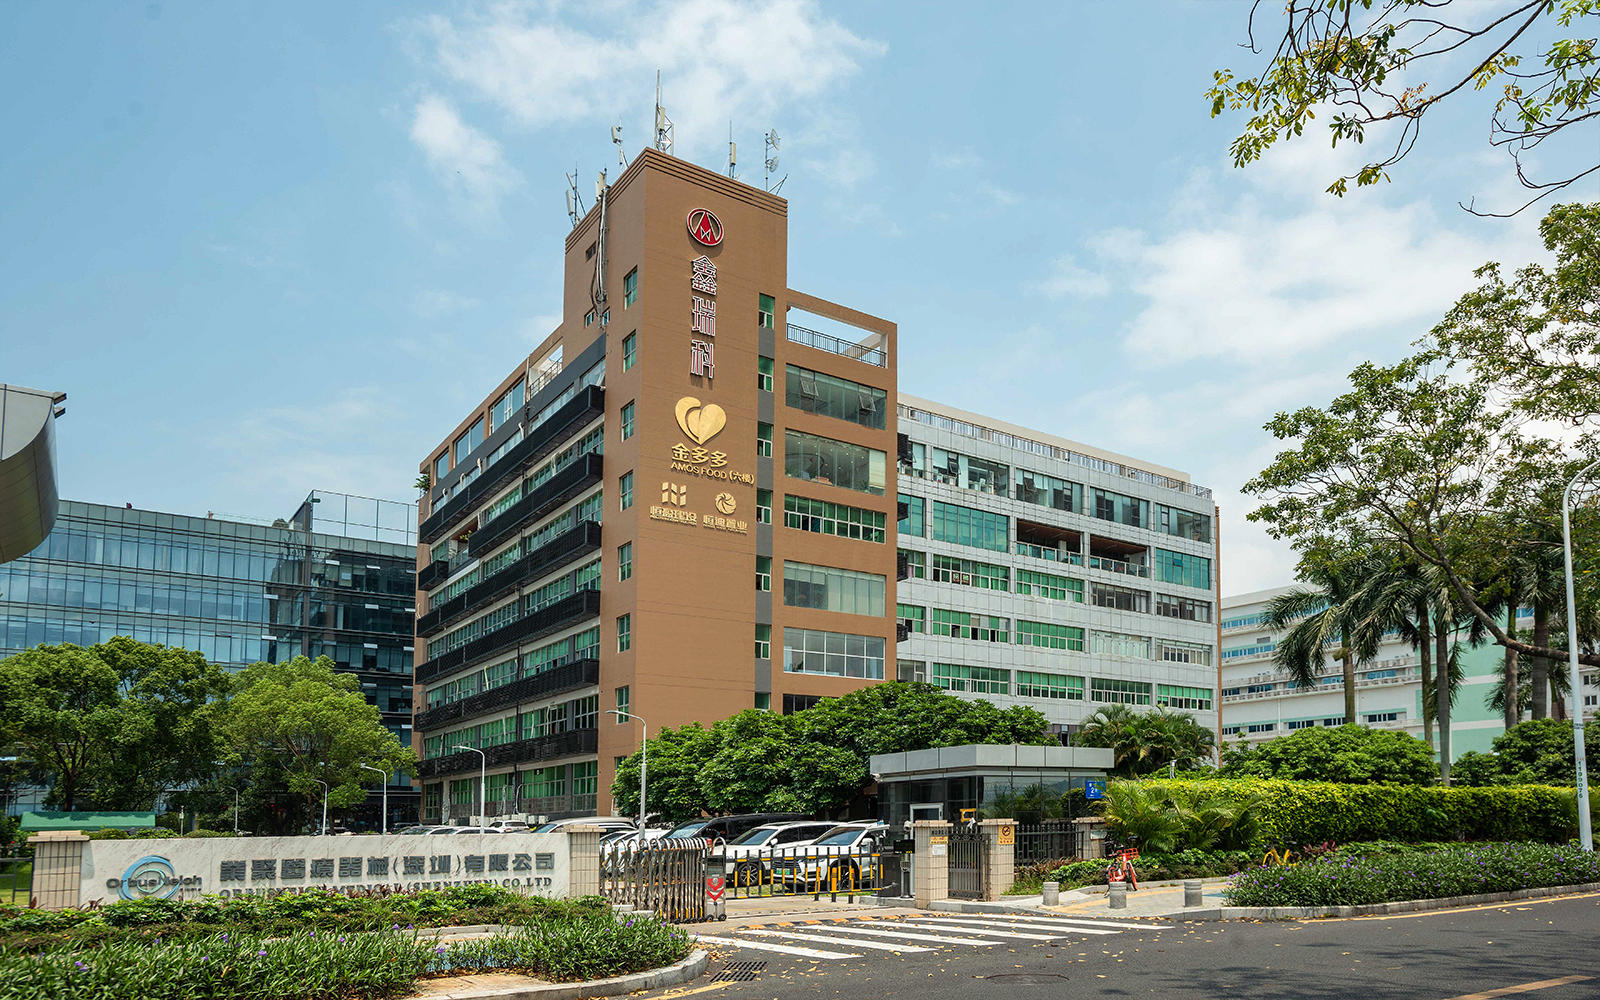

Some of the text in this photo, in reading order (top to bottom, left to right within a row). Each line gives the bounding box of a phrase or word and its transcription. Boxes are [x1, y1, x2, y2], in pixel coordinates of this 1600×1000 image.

[691, 254, 717, 379] 鑫瑞科
[671, 443, 727, 468] 金多多
[670, 461, 700, 474] AMOS
[701, 468, 727, 479] FOOD
[106, 875, 202, 888] OrbusNeich
